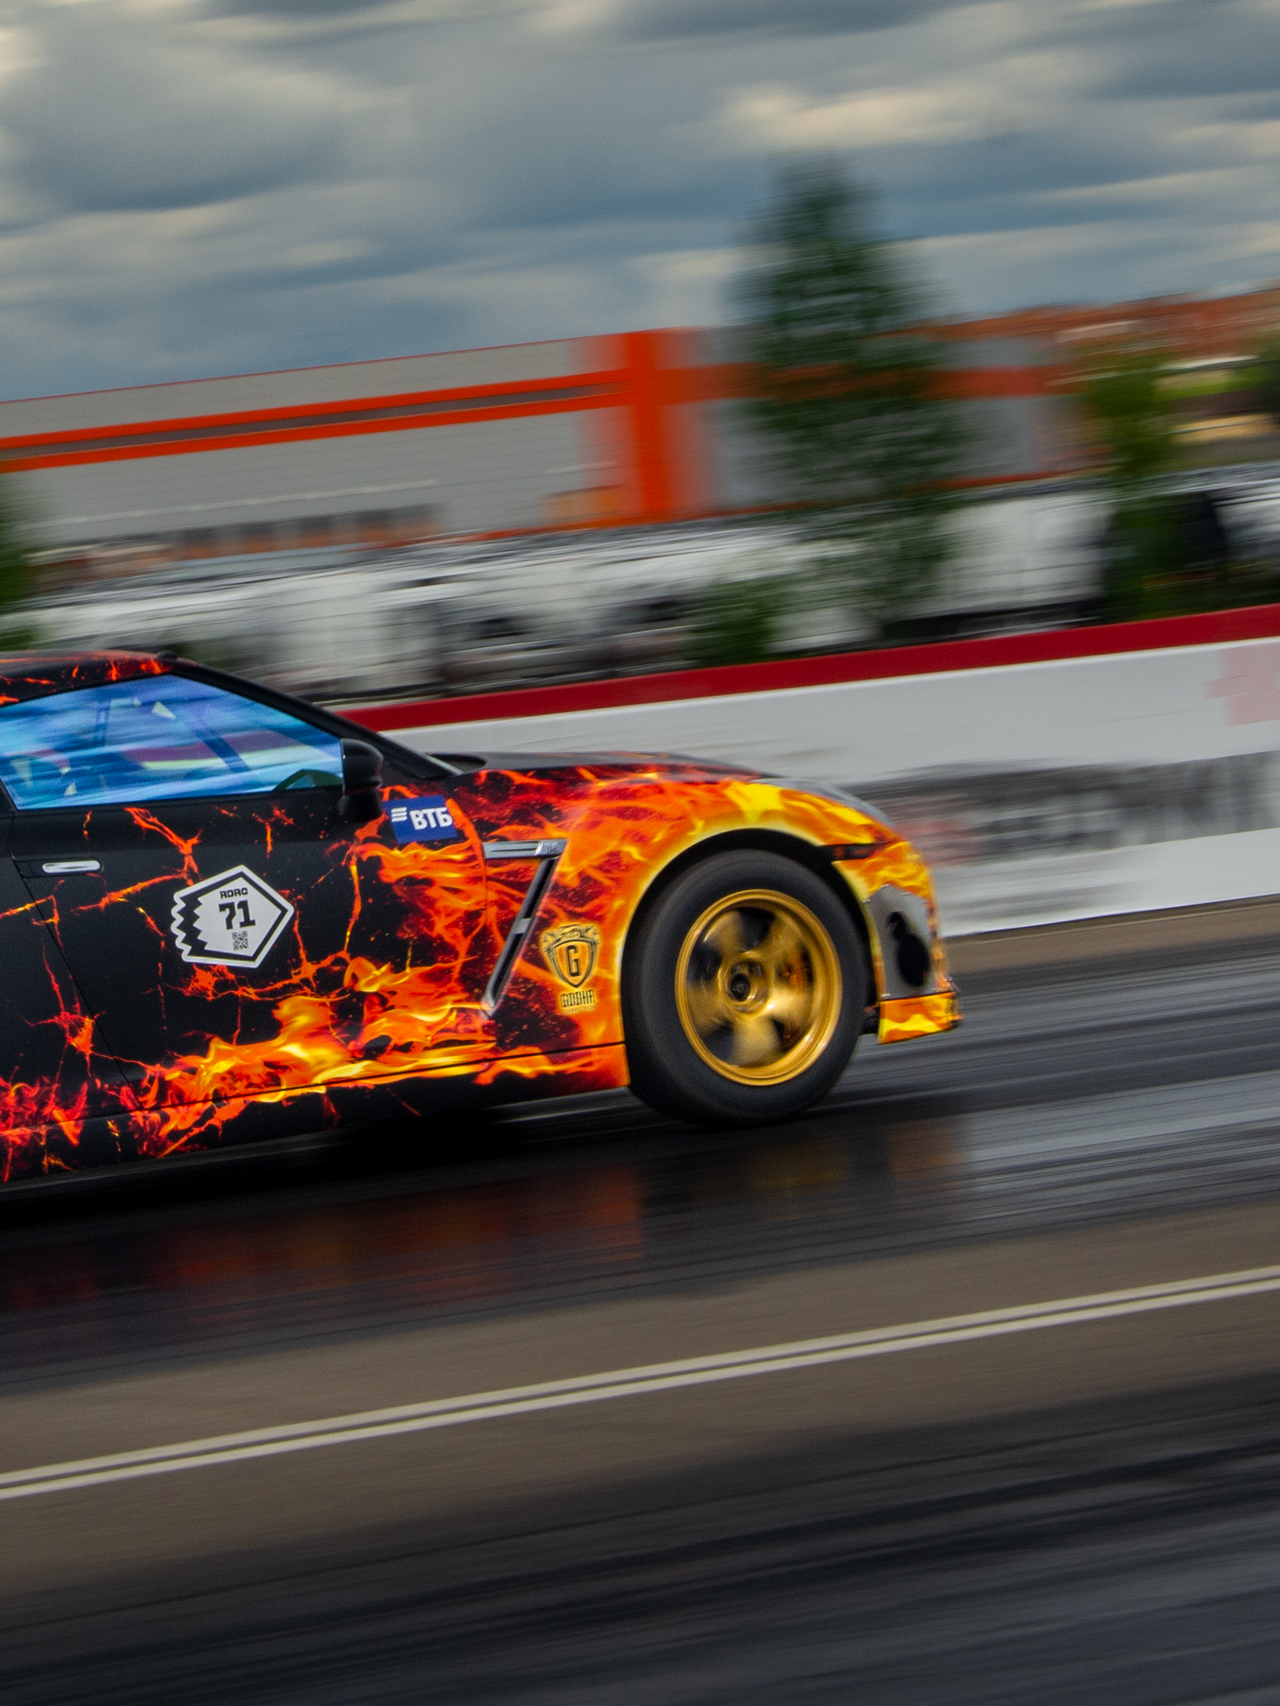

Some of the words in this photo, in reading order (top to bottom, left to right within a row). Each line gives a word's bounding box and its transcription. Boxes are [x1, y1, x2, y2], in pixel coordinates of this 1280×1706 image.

[409, 806, 453, 830] ВТБ
[219, 887, 249, 899] RDRC
[218, 899, 256, 931] 71
[566, 944, 580, 977] G
